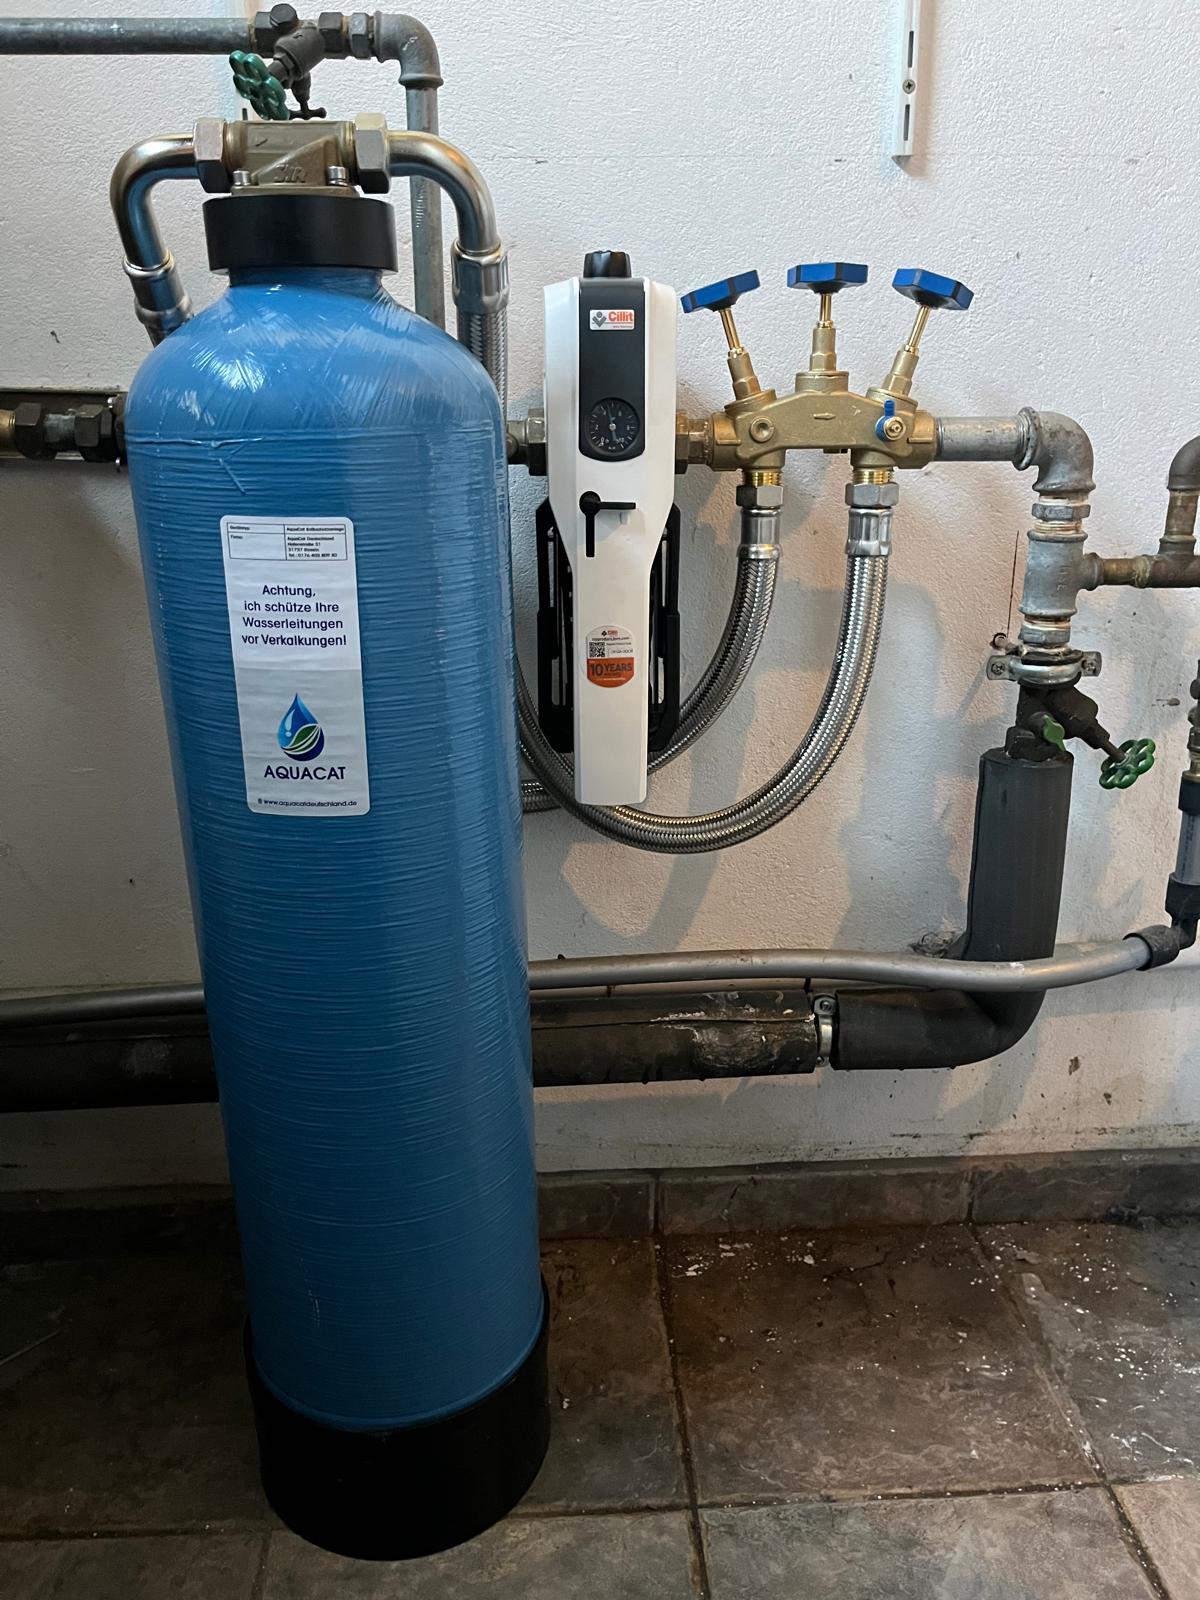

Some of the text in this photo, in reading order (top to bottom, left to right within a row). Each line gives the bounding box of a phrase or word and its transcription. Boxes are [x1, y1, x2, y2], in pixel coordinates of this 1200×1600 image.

[608, 311, 633, 322] Cillit
[262, 585, 316, 599] Achtung,
[244, 600, 340, 613] ich schütze Ihre
[242, 616, 343, 632] Wasserleitungen
[242, 633, 347, 649] vor Verkalkungen!
[591, 663, 604, 677] 10
[605, 662, 632, 672] YEARS
[263, 764, 346, 780] AQUACAT
